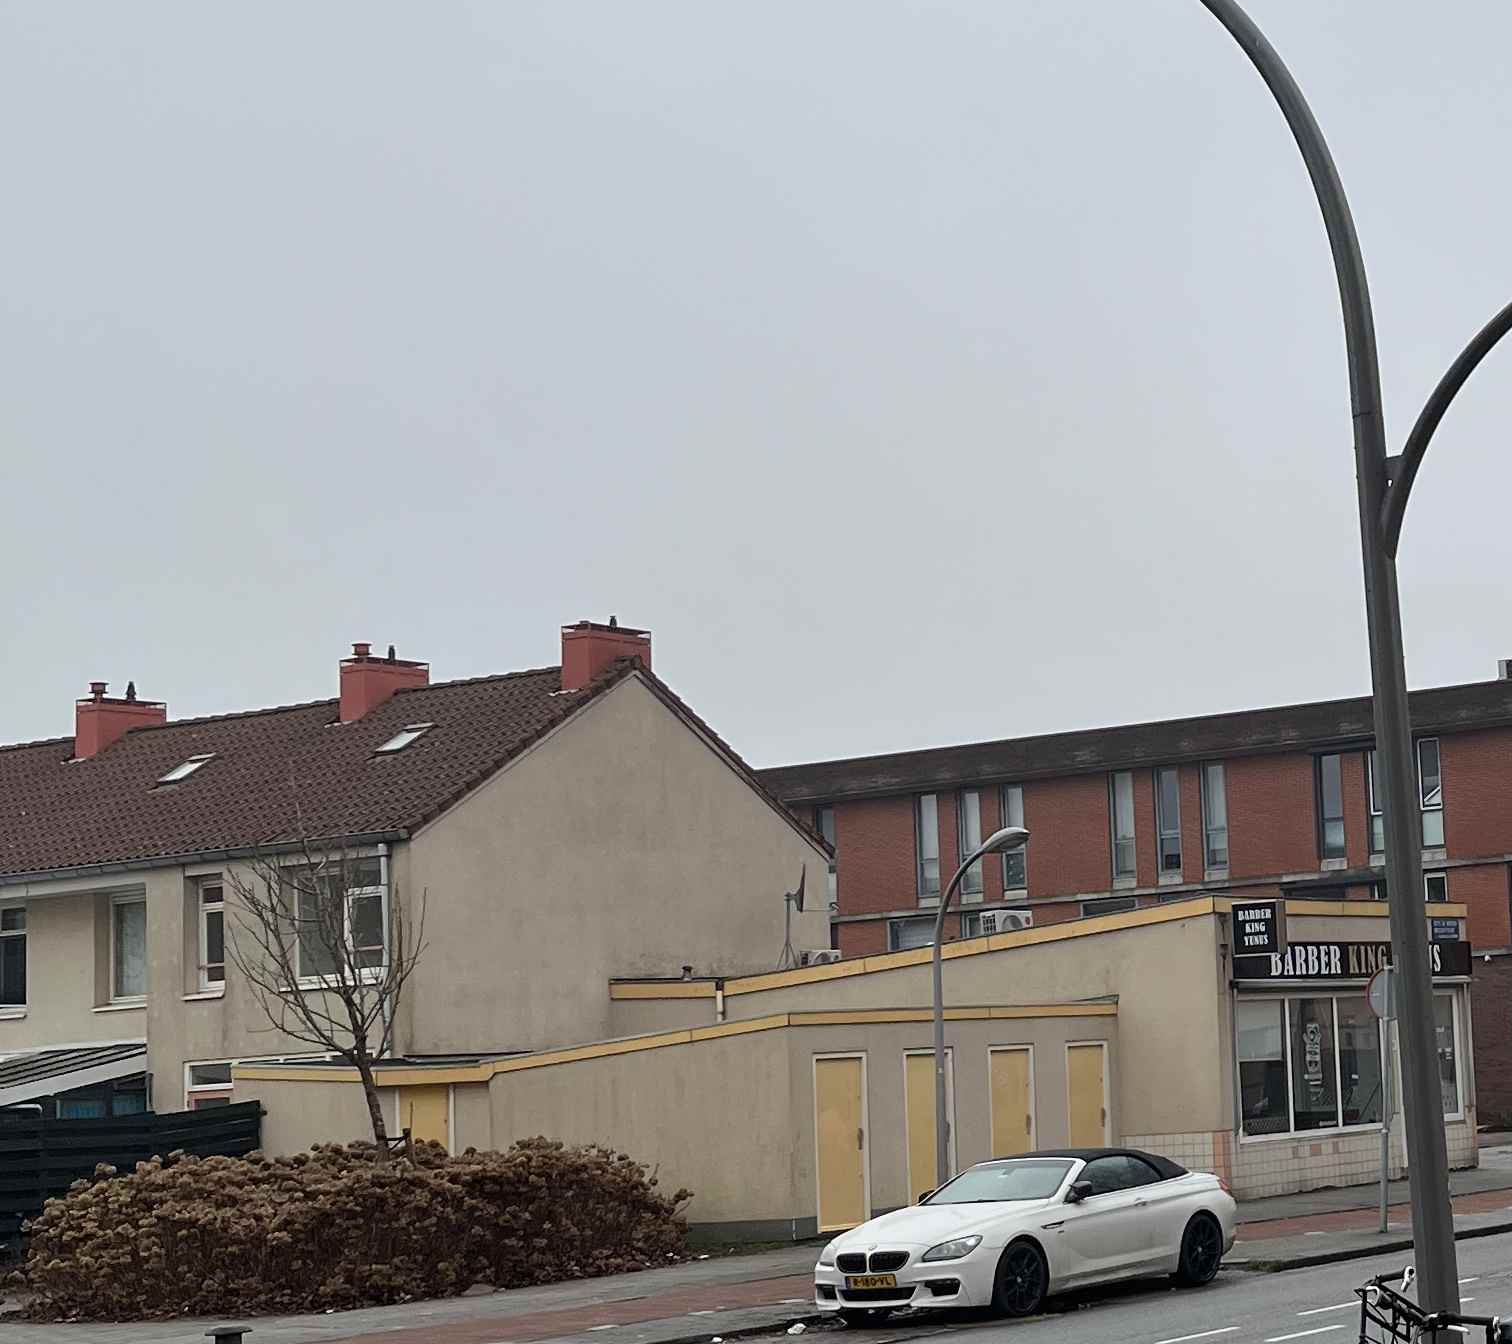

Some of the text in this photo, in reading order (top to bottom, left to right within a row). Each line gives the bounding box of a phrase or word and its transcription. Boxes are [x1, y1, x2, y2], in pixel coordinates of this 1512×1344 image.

[1238, 908, 1272, 921] BARBER
[1245, 922, 1266, 933] KING
[1243, 934, 1269, 946] YUNUS
[1270, 944, 1387, 976] BARBER KING
